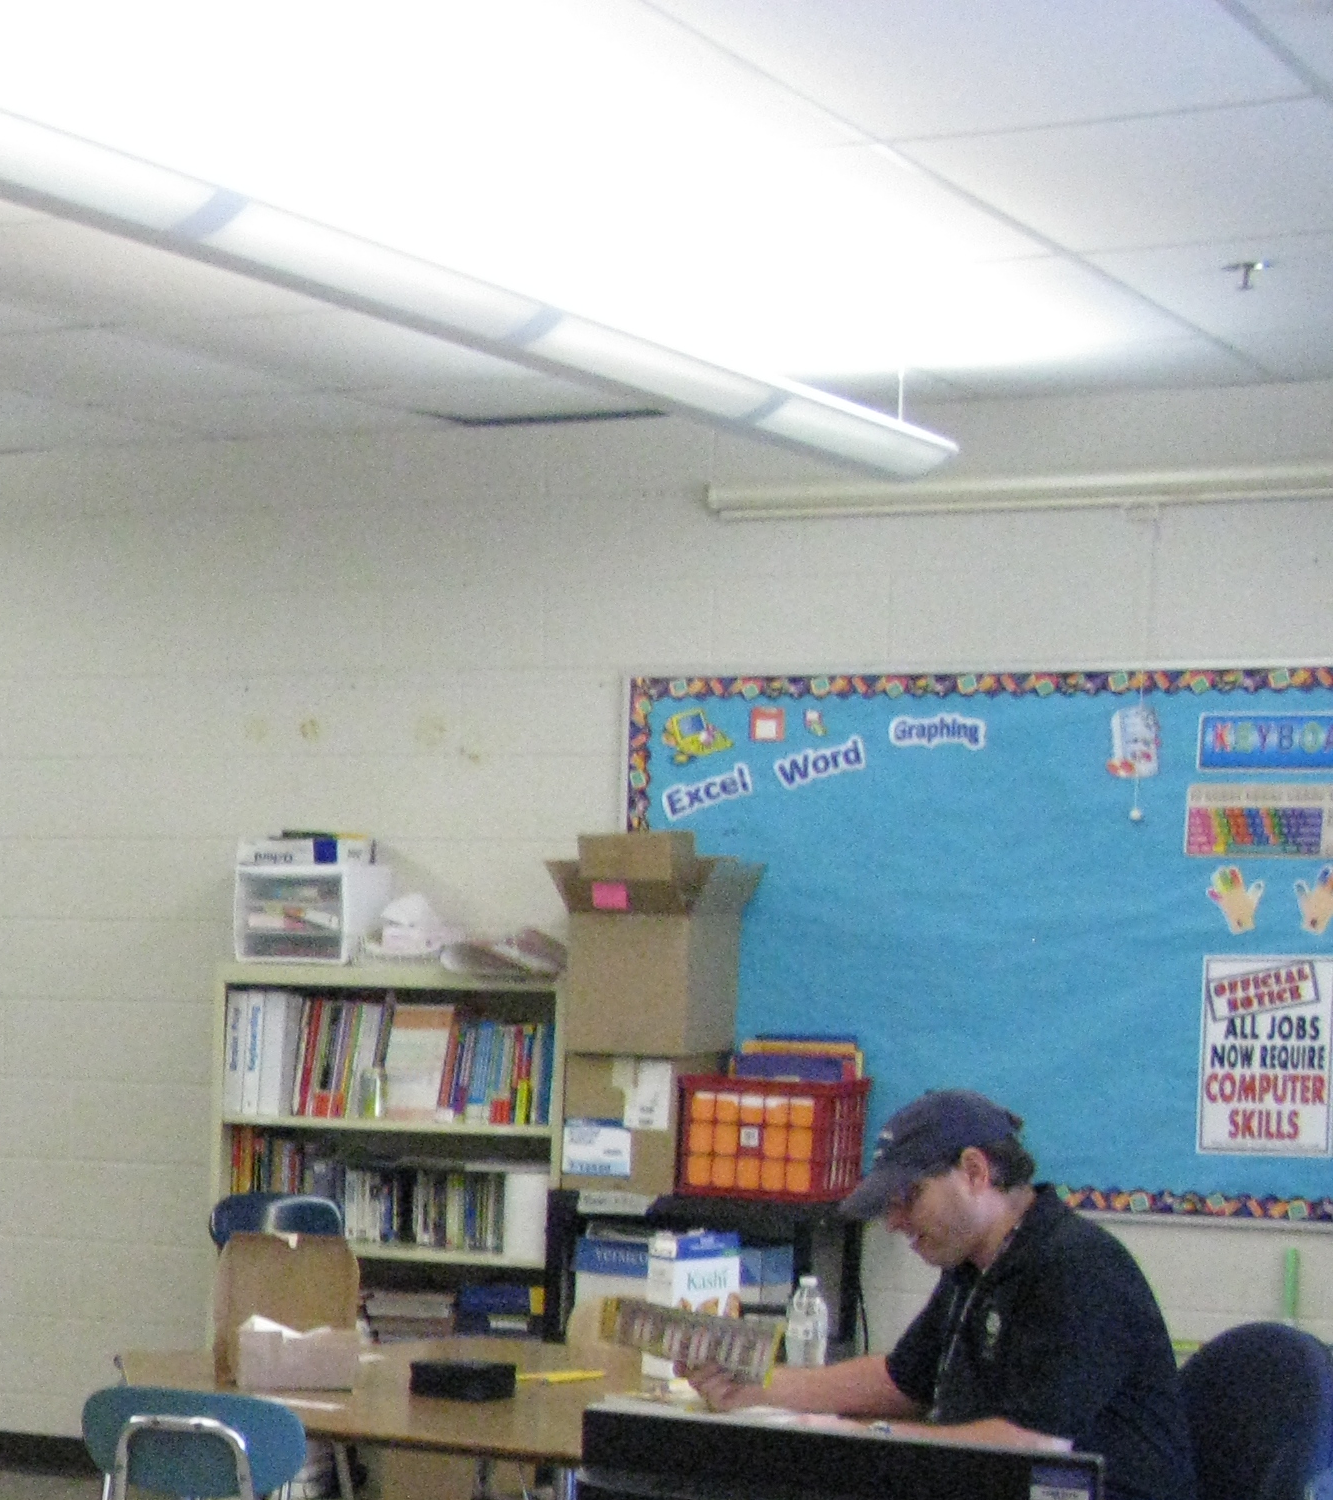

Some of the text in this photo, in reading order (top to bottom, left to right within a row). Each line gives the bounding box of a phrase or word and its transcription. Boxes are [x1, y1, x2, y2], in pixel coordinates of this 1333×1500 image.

[892, 717, 979, 745] Graphing
[777, 739, 863, 786] Word
[665, 766, 751, 816] Excel
[1214, 966, 1309, 998] OFFICIAL
[1228, 985, 1302, 1012] NOTICE
[1224, 1013, 1320, 1041] ALL JOBS
[1210, 1044, 1325, 1070] NOW REQUIRE
[1205, 1072, 1326, 1105] COMPUTER
[1228, 1109, 1301, 1140] SKILLS
[687, 1266, 729, 1291] Kashi
